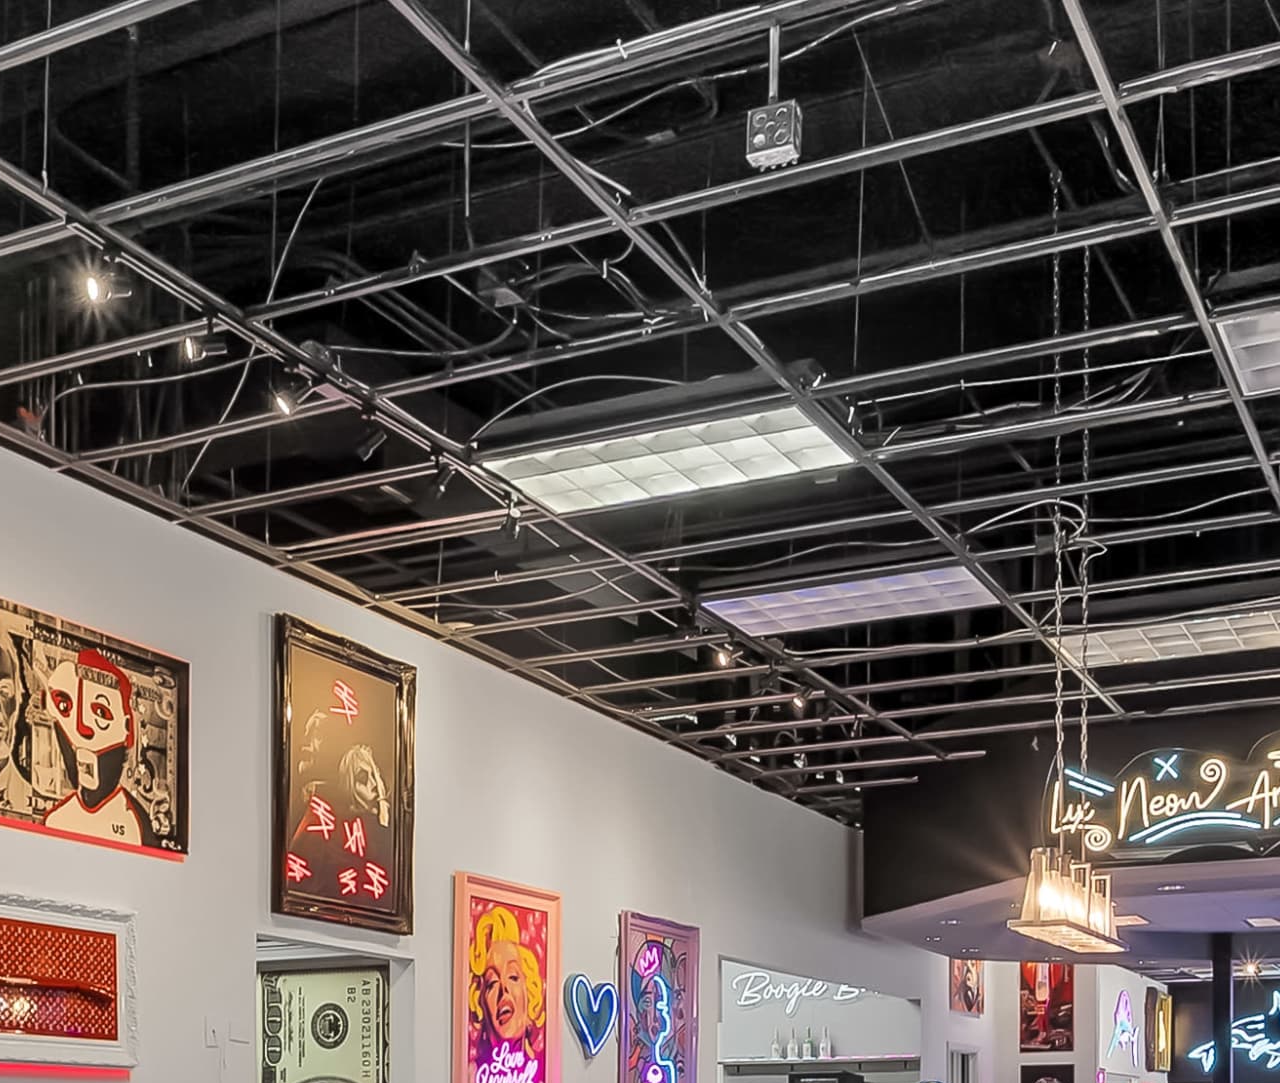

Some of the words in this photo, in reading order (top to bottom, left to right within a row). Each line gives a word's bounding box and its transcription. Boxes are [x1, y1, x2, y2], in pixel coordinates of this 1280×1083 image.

[1118, 759, 1228, 840] Neon
[112, 823, 126, 837] US
[732, 971, 828, 1015] Boogie
[490, 1041, 526, 1074] Love
